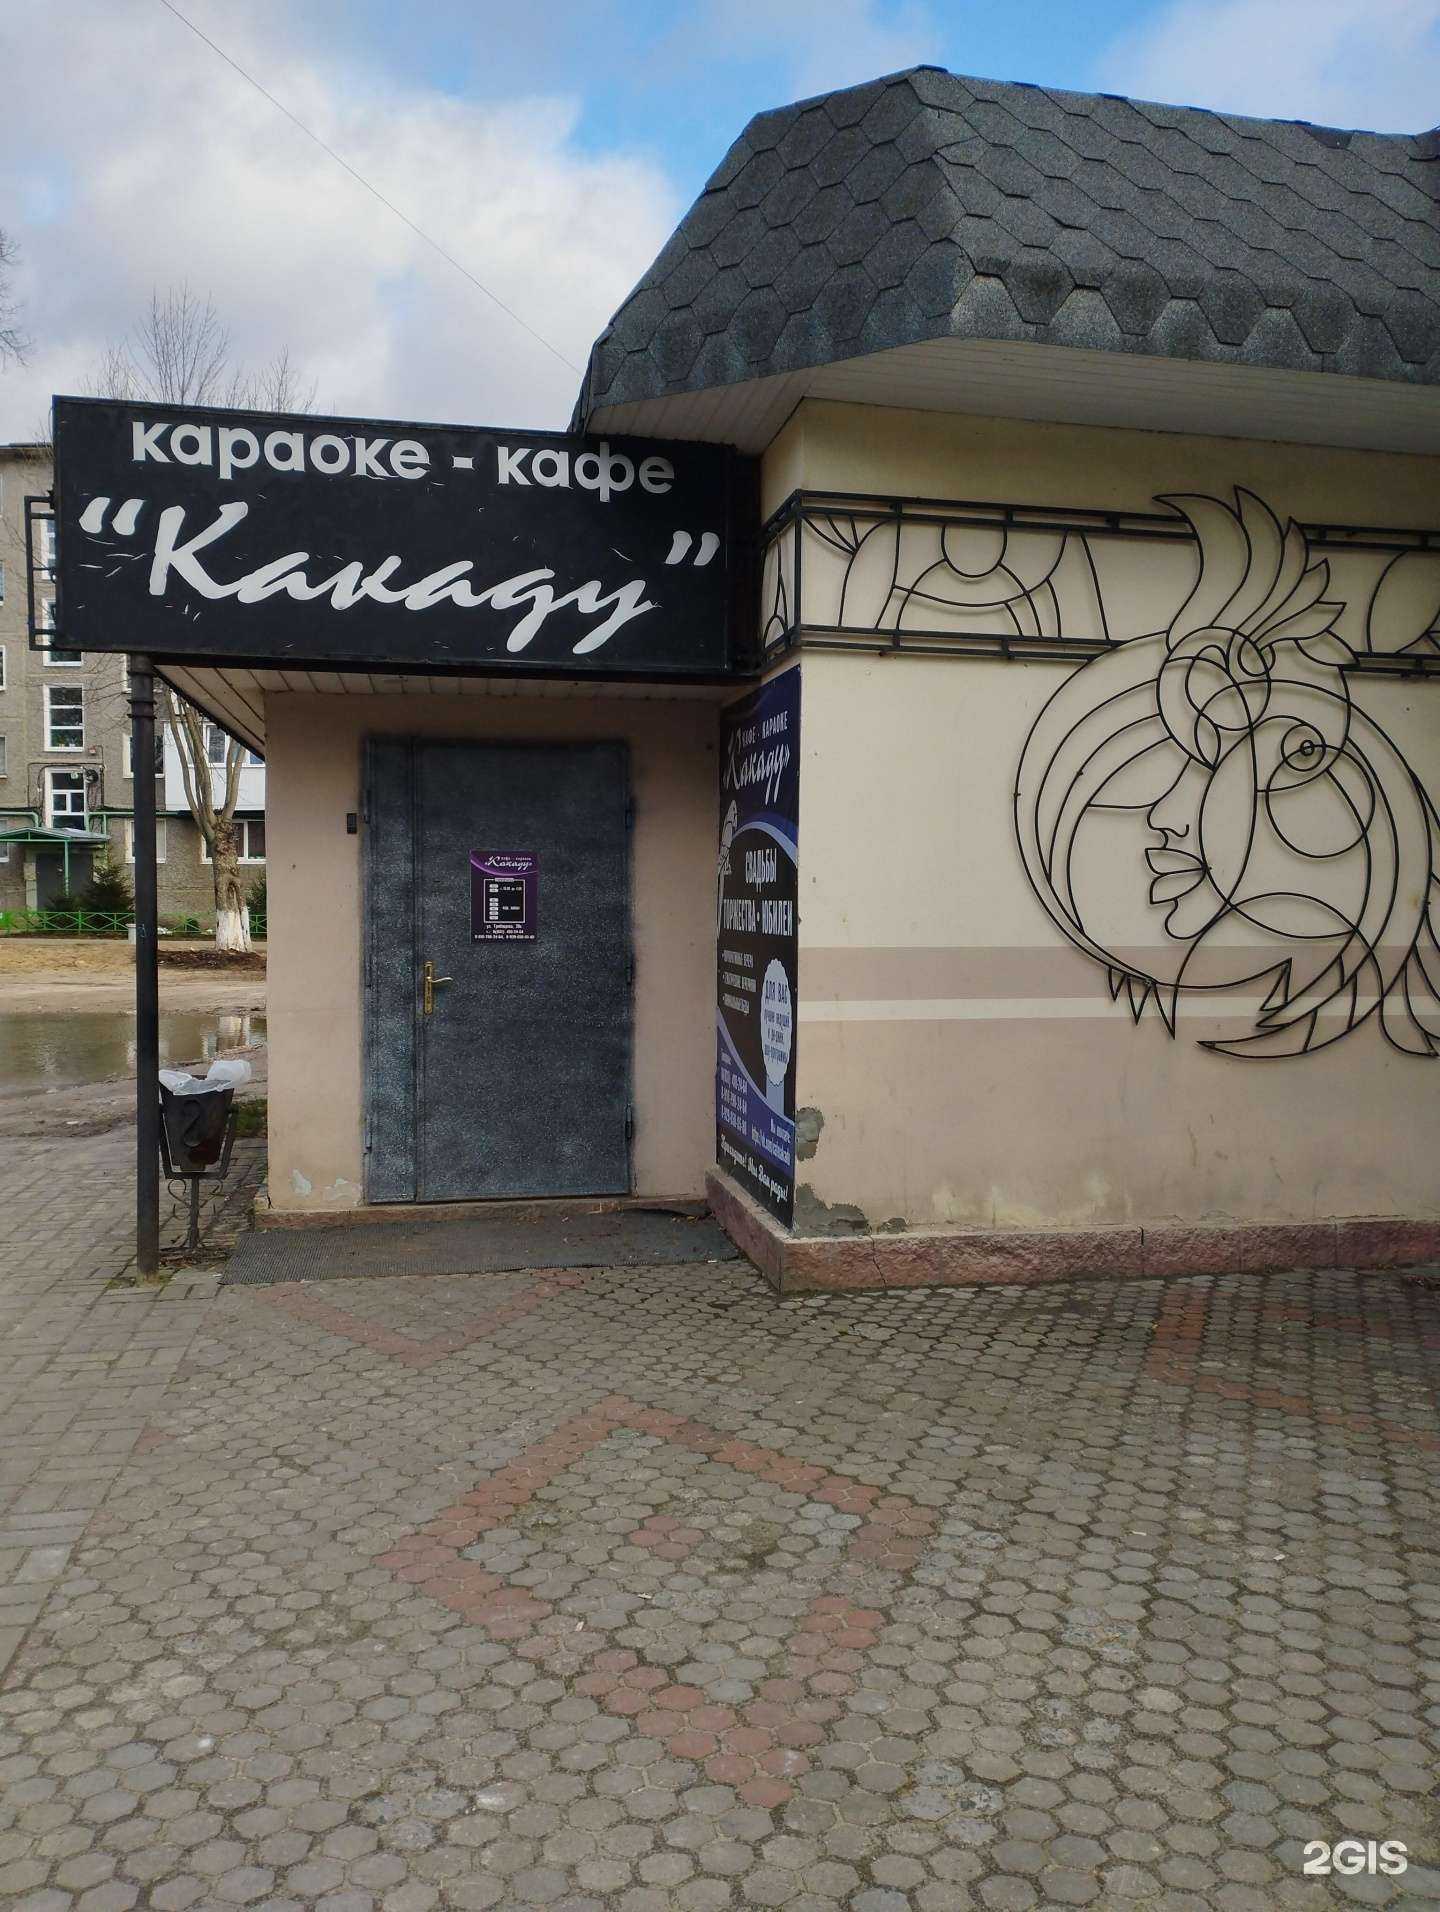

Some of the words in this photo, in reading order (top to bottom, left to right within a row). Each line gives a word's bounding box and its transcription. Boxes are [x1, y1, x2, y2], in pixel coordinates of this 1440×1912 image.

[131, 421, 430, 480] караоке
[497, 440, 676, 503] кафе
[762, 710, 788, 739] КАРАОКЕ
[745, 847, 777, 892] СВАДЬБЫ
[723, 900, 757, 932] ТОРЖЕСТВА
[764, 979, 776, 1005] ДЛЯ
[777, 982, 788, 1005] ВАС
